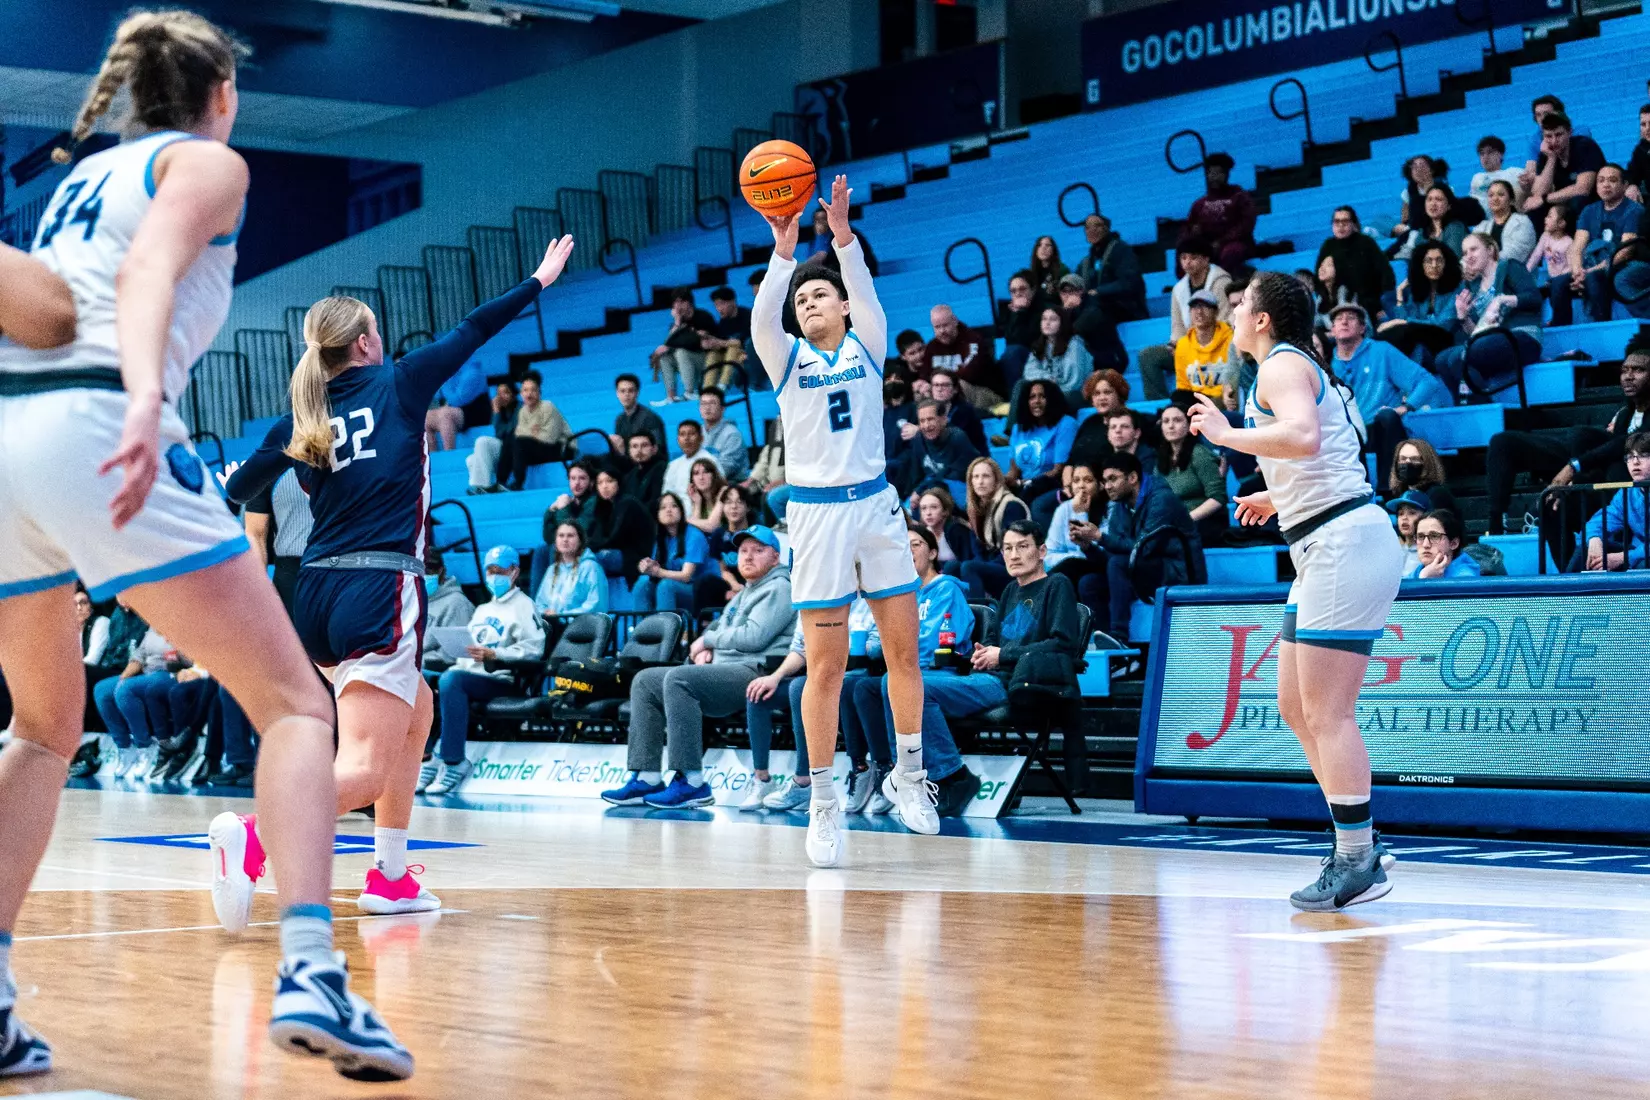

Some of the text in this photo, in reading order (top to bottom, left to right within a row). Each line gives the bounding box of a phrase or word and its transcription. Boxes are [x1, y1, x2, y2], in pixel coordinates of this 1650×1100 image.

[752, 185, 794, 201] ELITE
[39, 170, 112, 248] 34
[799, 365, 867, 389] COLUMBIA
[827, 389, 853, 432] 2
[327, 407, 377, 473] 22
[846, 487, 857, 500] C
[1239, 704, 1597, 734] PHAL THERAPY
[1398, 774, 1455, 784] DAKTRONICS
